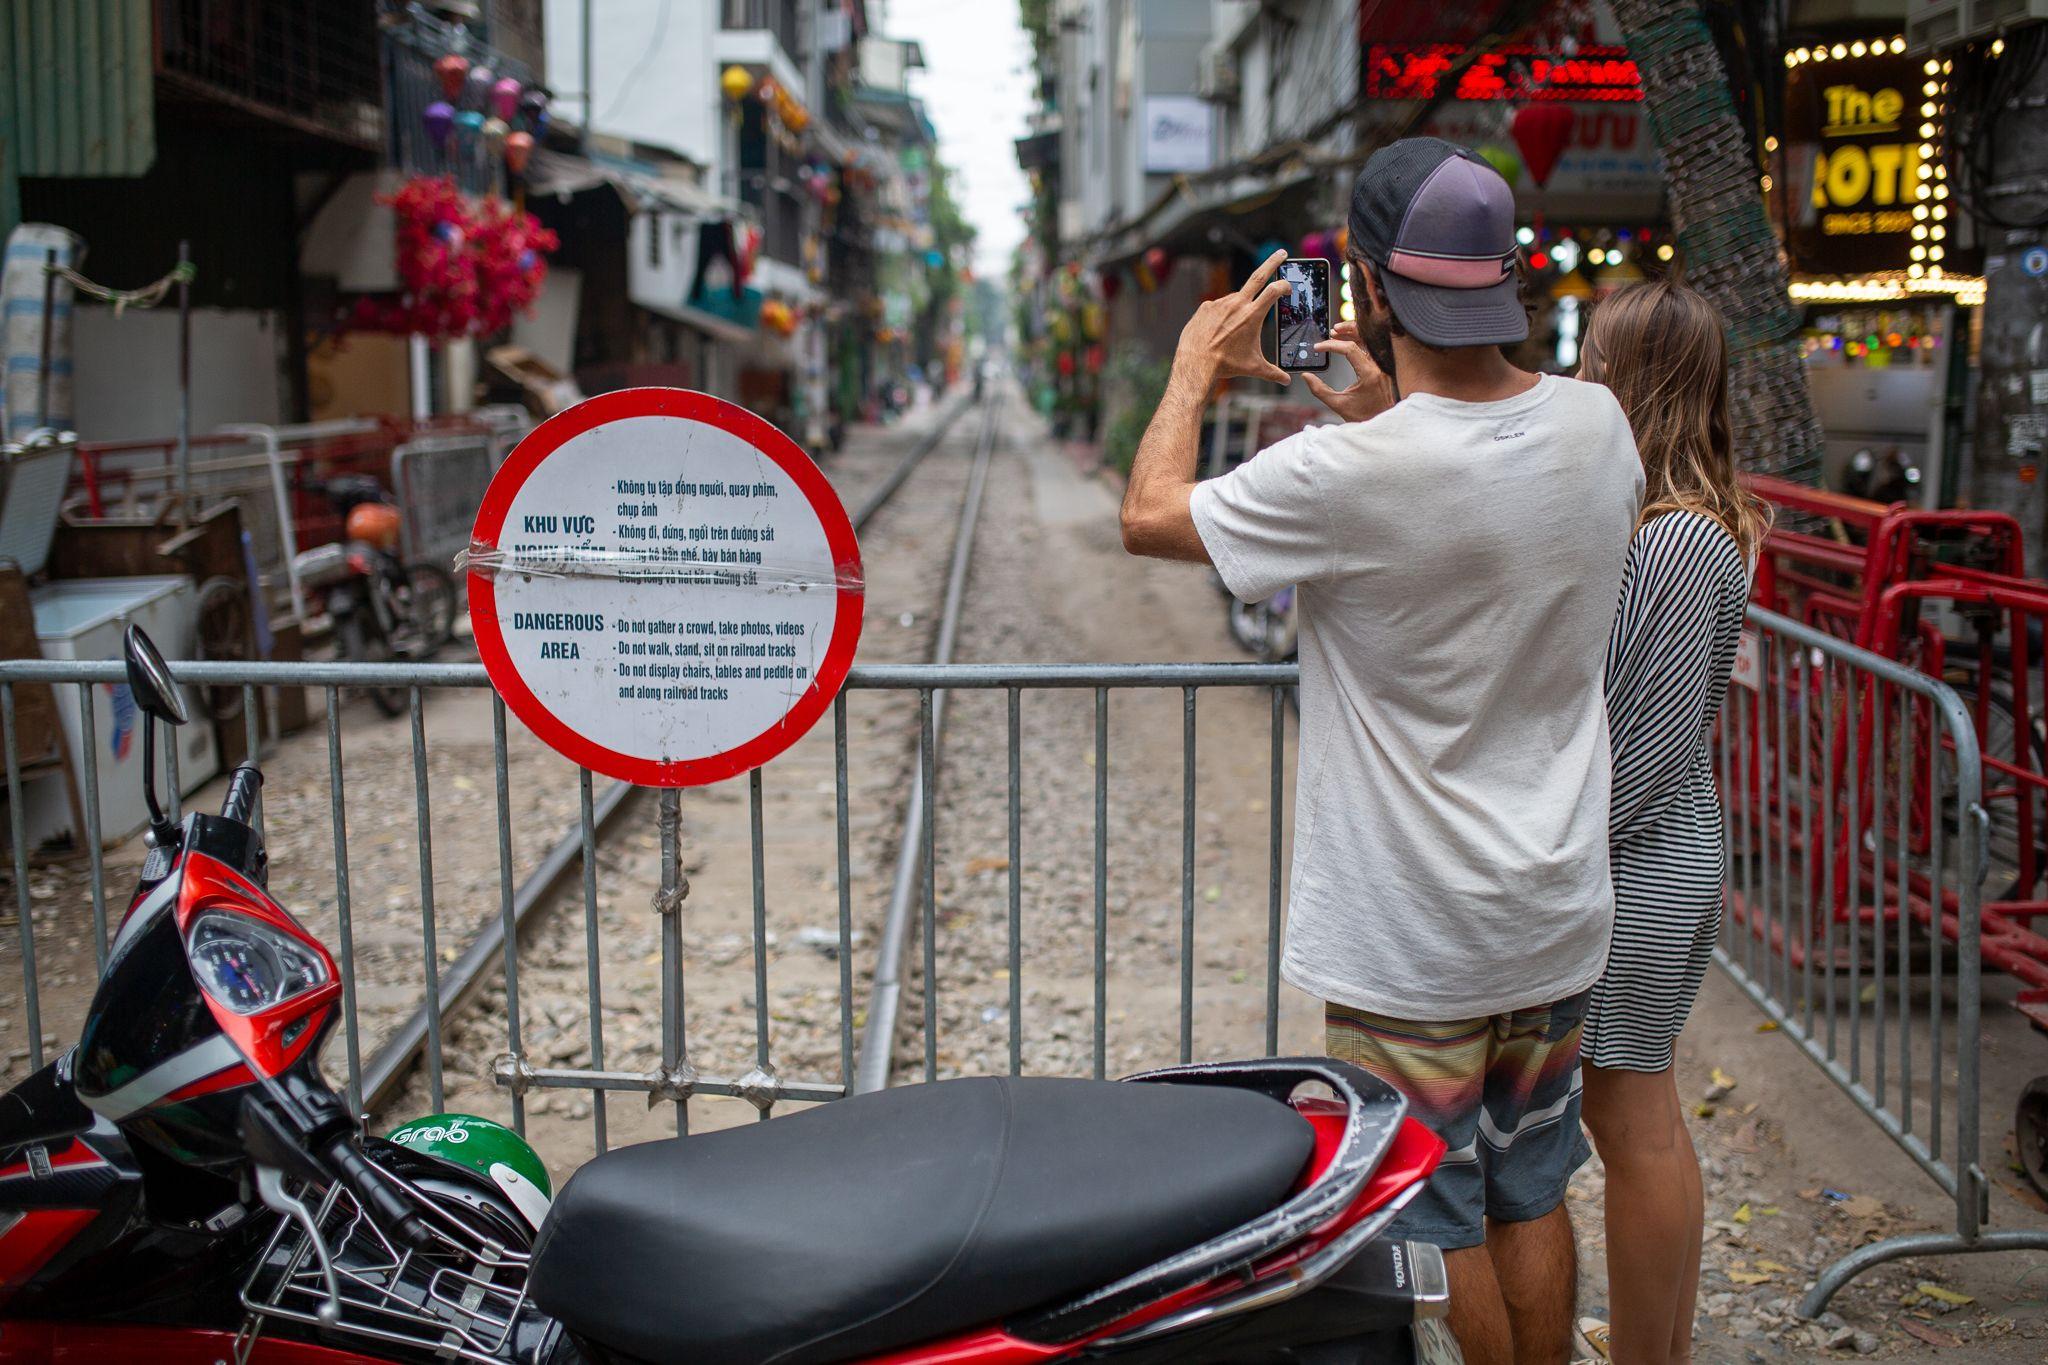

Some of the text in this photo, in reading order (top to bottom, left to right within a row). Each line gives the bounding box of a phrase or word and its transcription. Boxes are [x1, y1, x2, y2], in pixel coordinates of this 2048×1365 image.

[1823, 85, 1904, 127] The
[618, 480, 645, 496] Không
[659, 482, 673, 498] tập
[700, 480, 726, 497] người,
[729, 483, 750, 497] quay
[753, 481, 778, 498] phim,
[618, 501, 657, 519] chụp ảnh
[524, 515, 594, 537] KHU VỰC
[619, 524, 774, 541] Không đi, đứng, ngồi trên đường sắt
[720, 548, 736, 562] bán
[740, 549, 761, 564] hàng
[514, 613, 604, 631] DANGEROUS
[618, 619, 804, 636] Do not gather a crowd, take photos, videos
[541, 642, 580, 659] AREA
[618, 641, 796, 657] Do not walk, stand, sit on railroad tracks
[619, 663, 806, 680] Do not display chairs, tables and peddle on
[619, 685, 728, 701] and along railroad tracks
[390, 1122, 468, 1145] Grab
